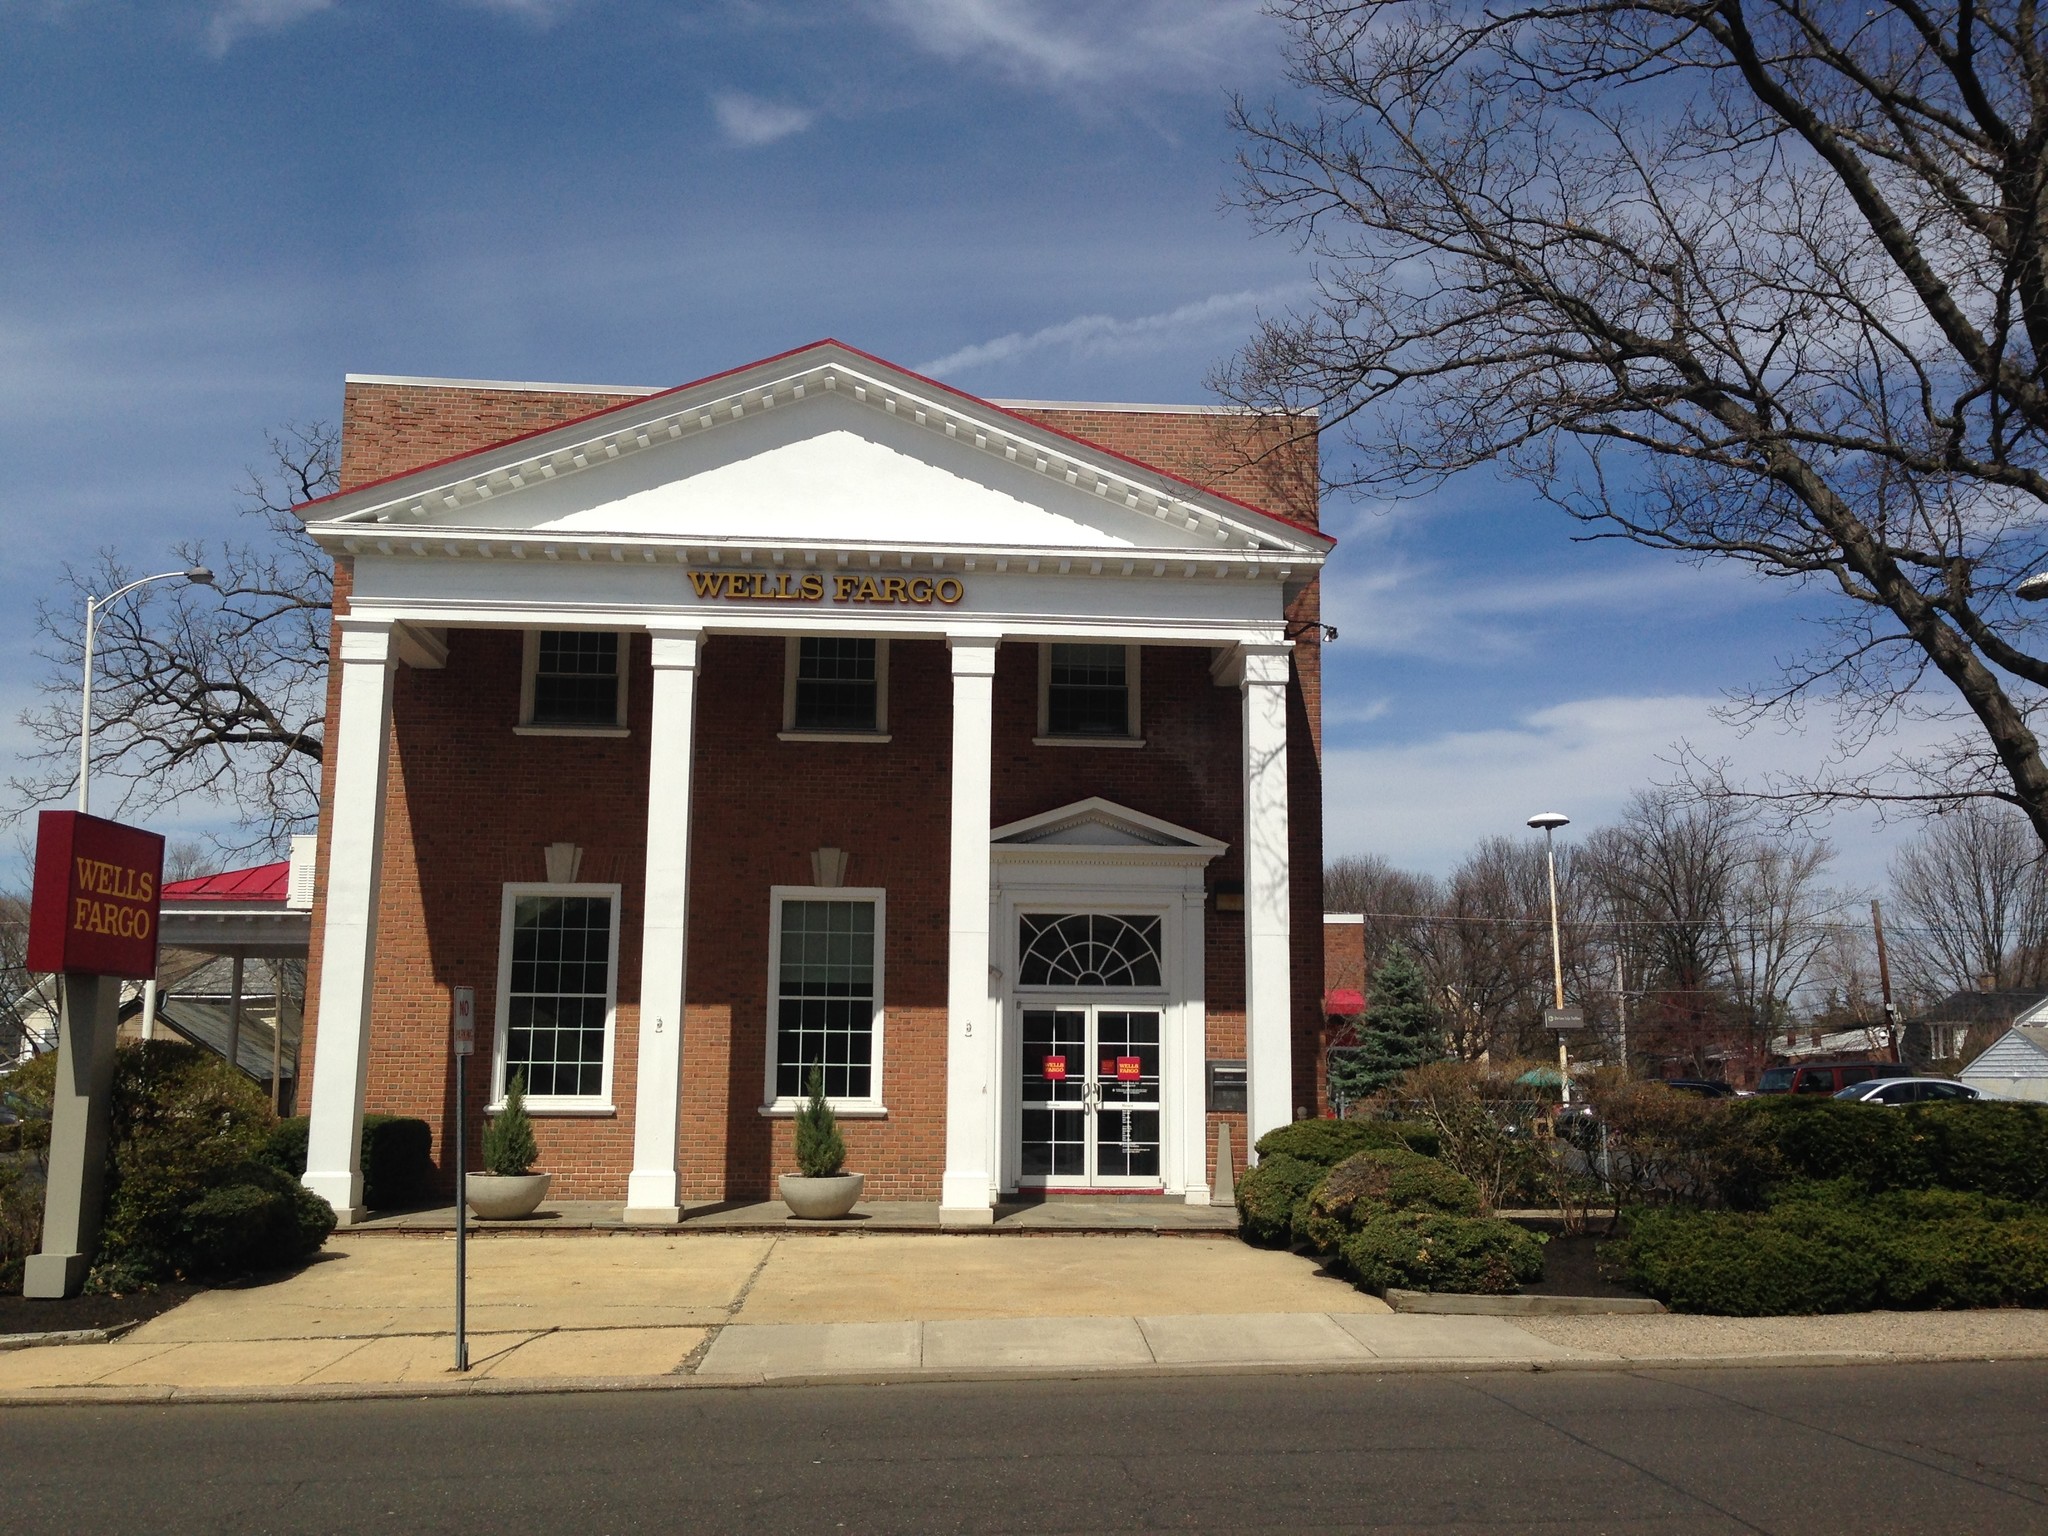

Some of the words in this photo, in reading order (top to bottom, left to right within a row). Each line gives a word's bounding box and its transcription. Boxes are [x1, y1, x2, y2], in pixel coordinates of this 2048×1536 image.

[687, 571, 824, 601] WELLS
[833, 575, 964, 604] FARGO
[76, 857, 153, 903] WELLS
[74, 897, 150, 940] FARGO
[459, 1000, 470, 1017] NO
